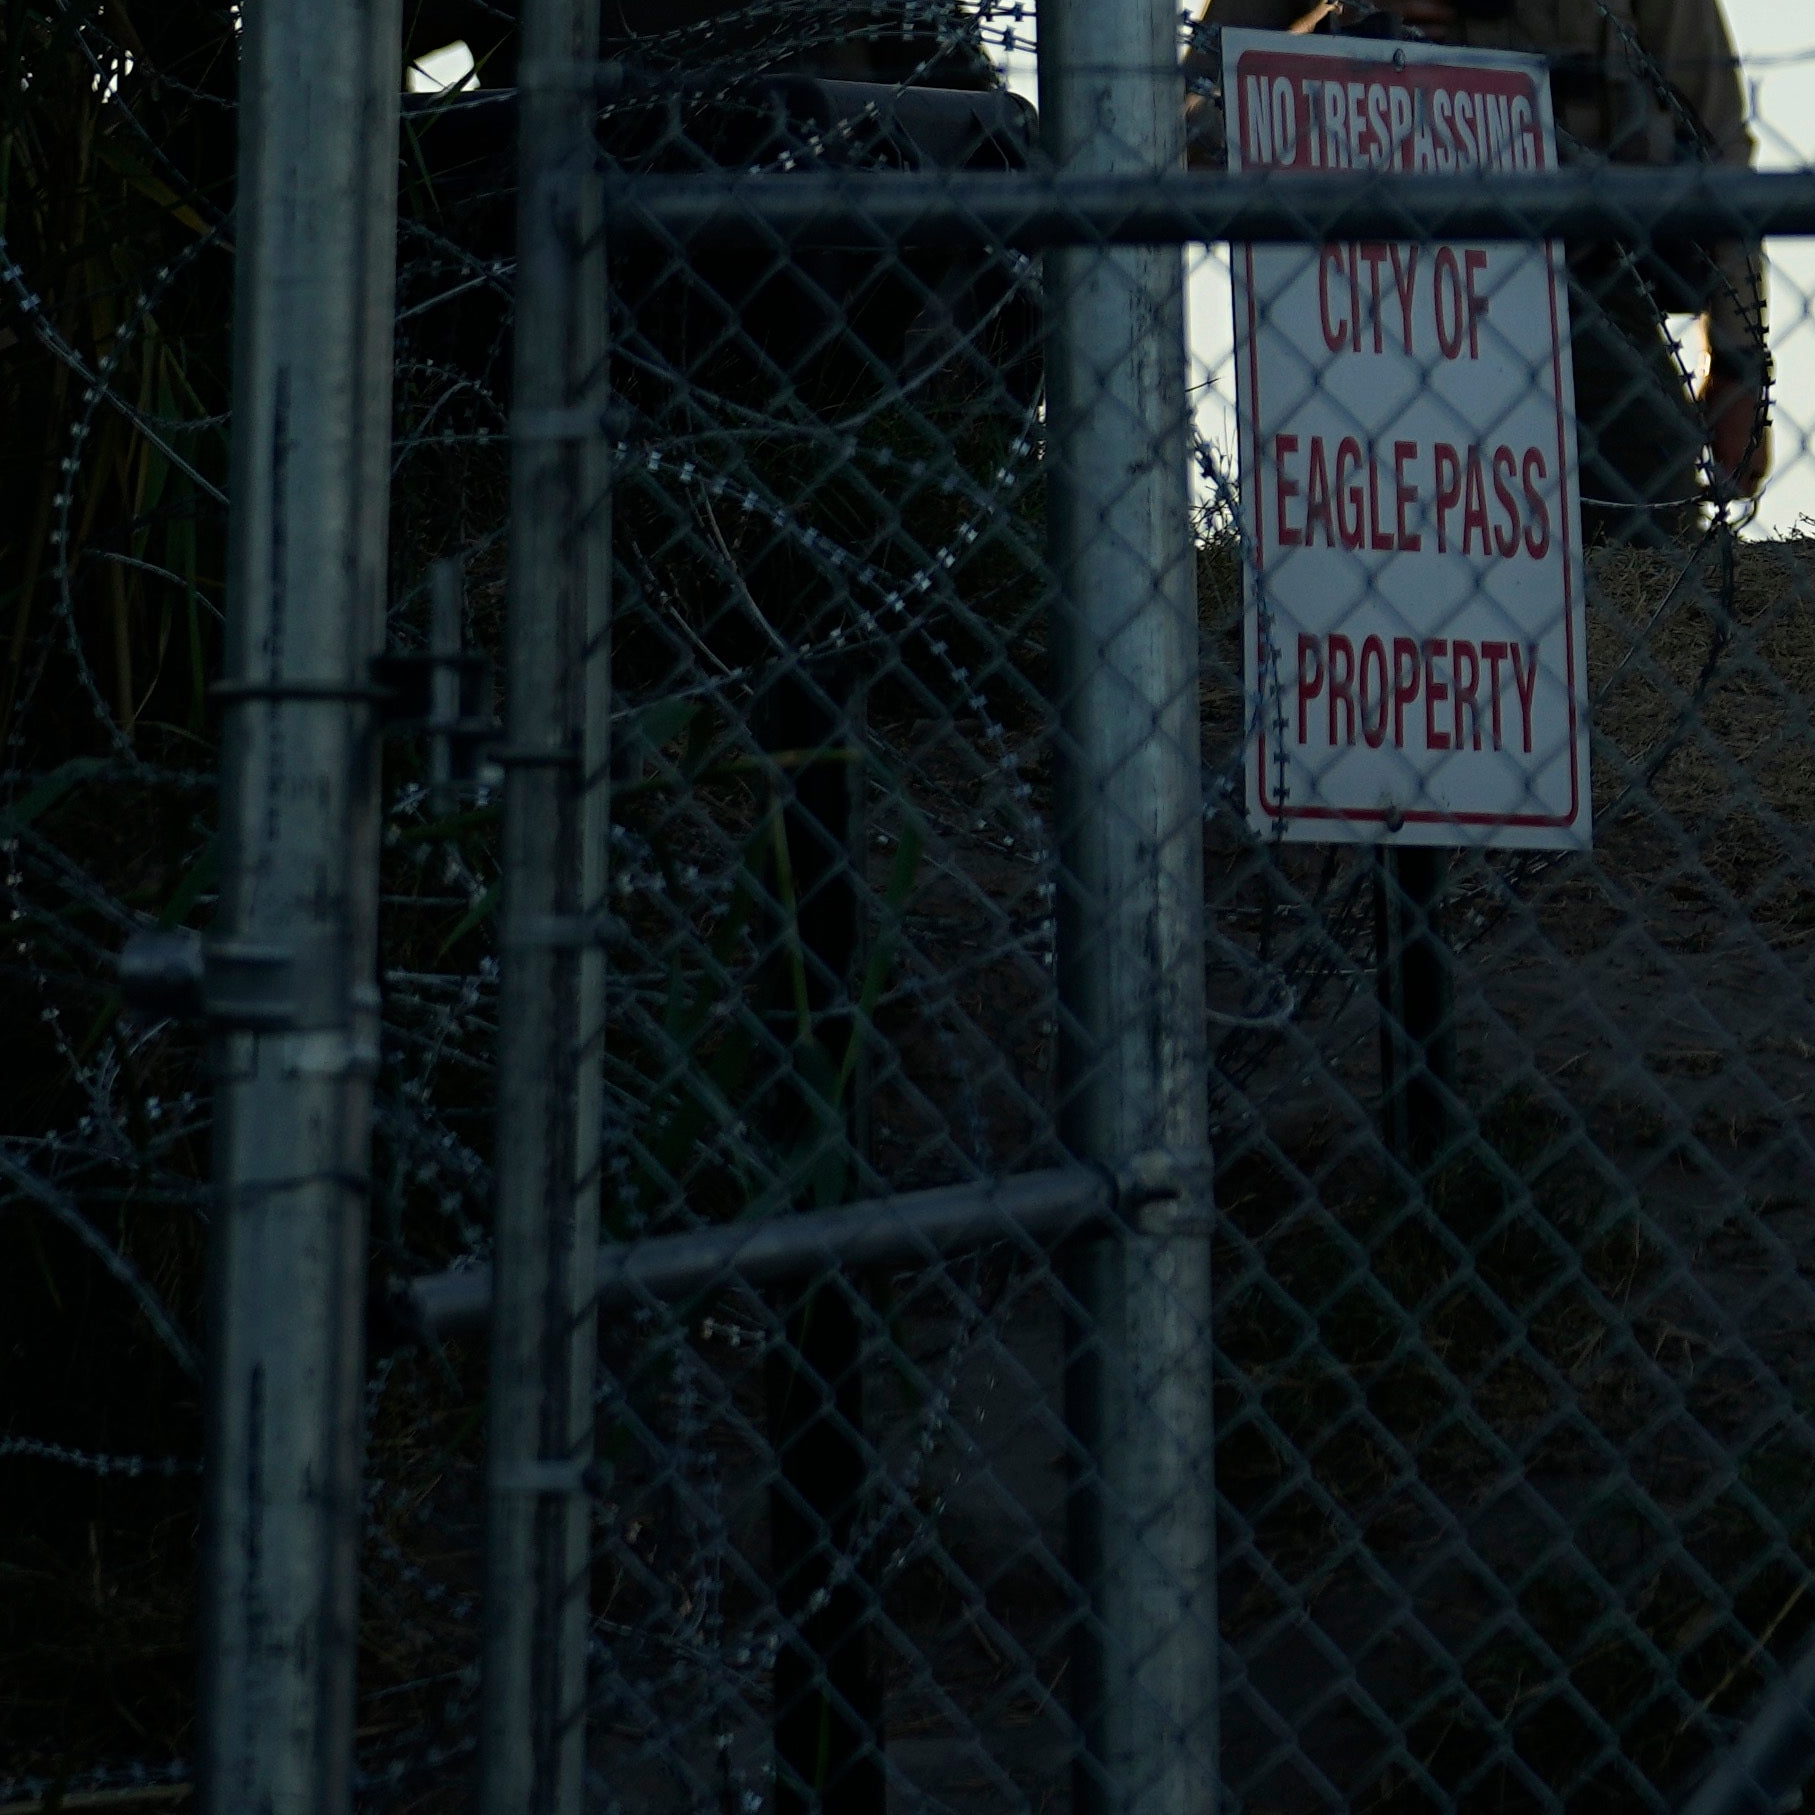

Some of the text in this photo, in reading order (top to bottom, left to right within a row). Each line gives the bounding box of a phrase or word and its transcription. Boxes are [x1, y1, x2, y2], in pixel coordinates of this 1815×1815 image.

[1245, 75, 1537, 172] NO TRESPASSING
[1319, 241, 1488, 359] CITY OF
[1276, 434, 1550, 559] EAGLE PASS
[1298, 633, 1537, 752] PROPERTY
